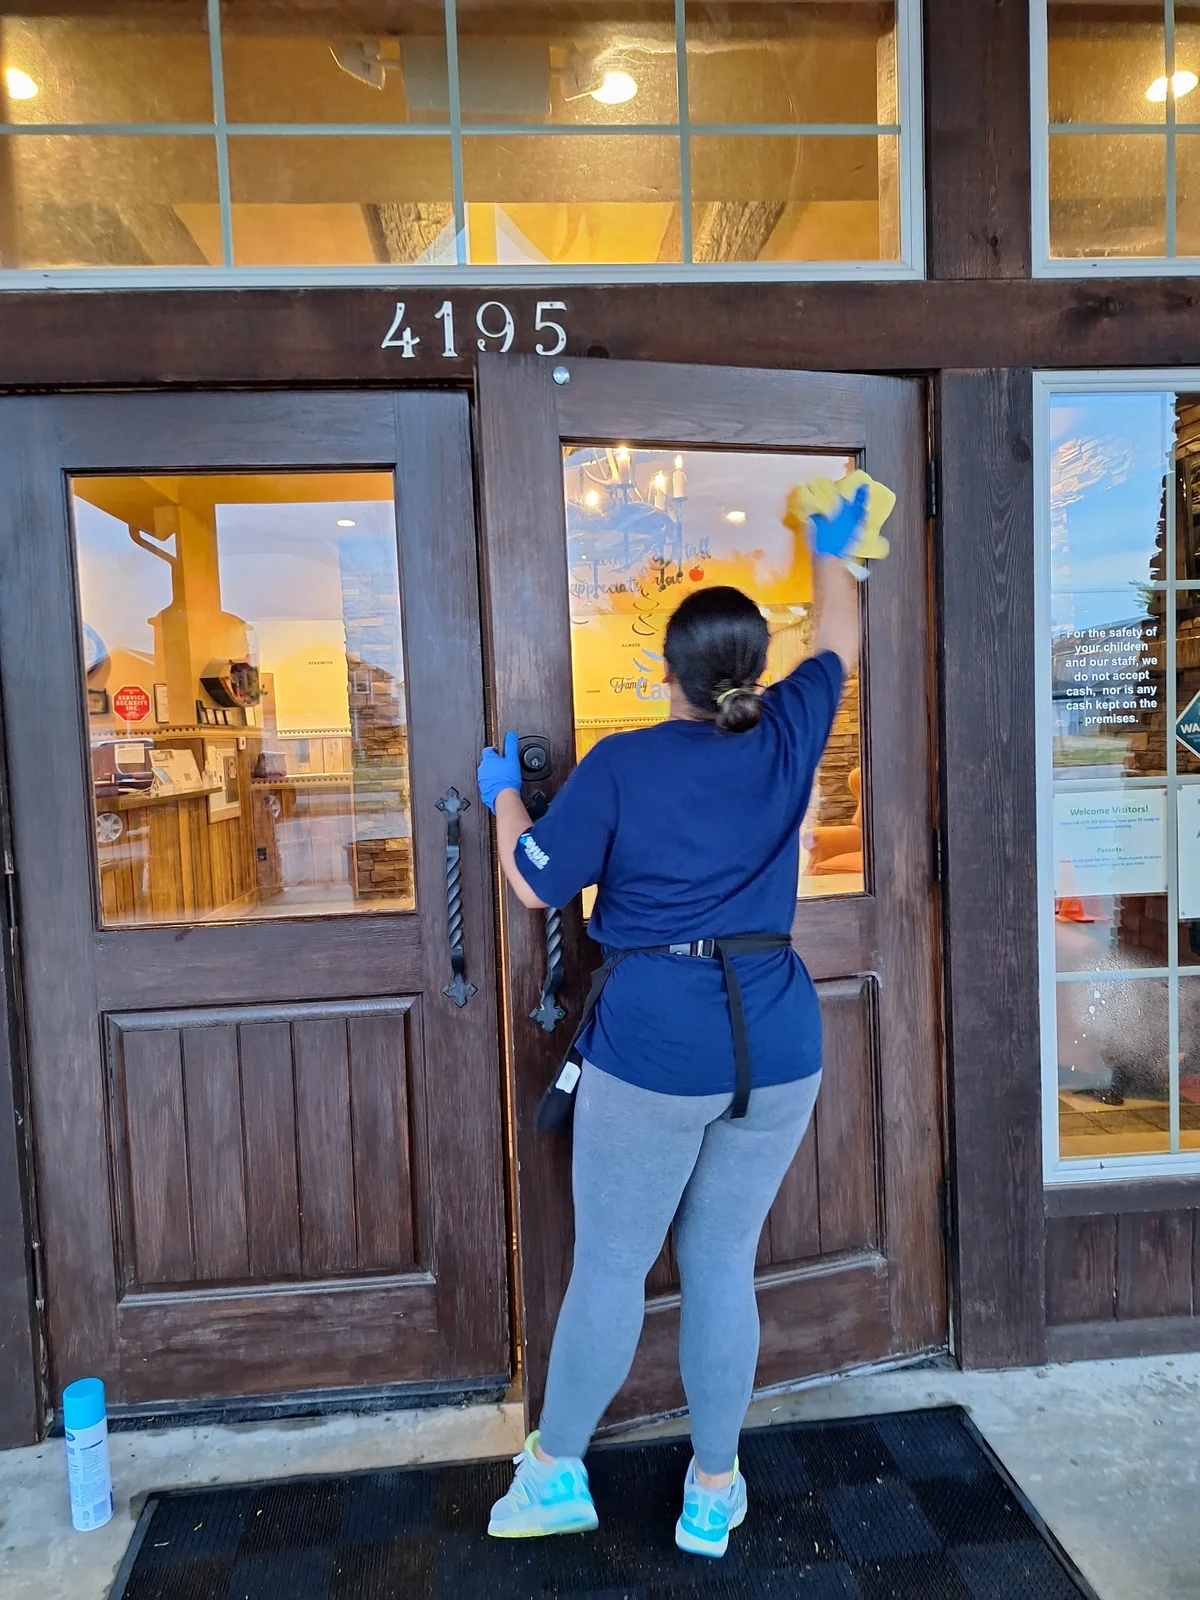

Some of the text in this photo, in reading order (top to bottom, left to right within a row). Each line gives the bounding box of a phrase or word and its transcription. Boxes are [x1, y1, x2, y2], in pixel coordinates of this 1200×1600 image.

[380, 300, 567, 358] 4195
[1066, 626, 1158, 639] For the safety of
[1075, 642, 1149, 655] your children
[1065, 656, 1158, 667] and our staff, we
[1074, 670, 1150, 682] do not accept
[609, 676, 648, 694] Famly
[1066, 684, 1158, 698] cash, nor is any
[1066, 699, 1158, 712] cash kept on the
[1084, 713, 1139, 726] premises.
[1070, 805, 1149, 816] Welcome Visitors!
